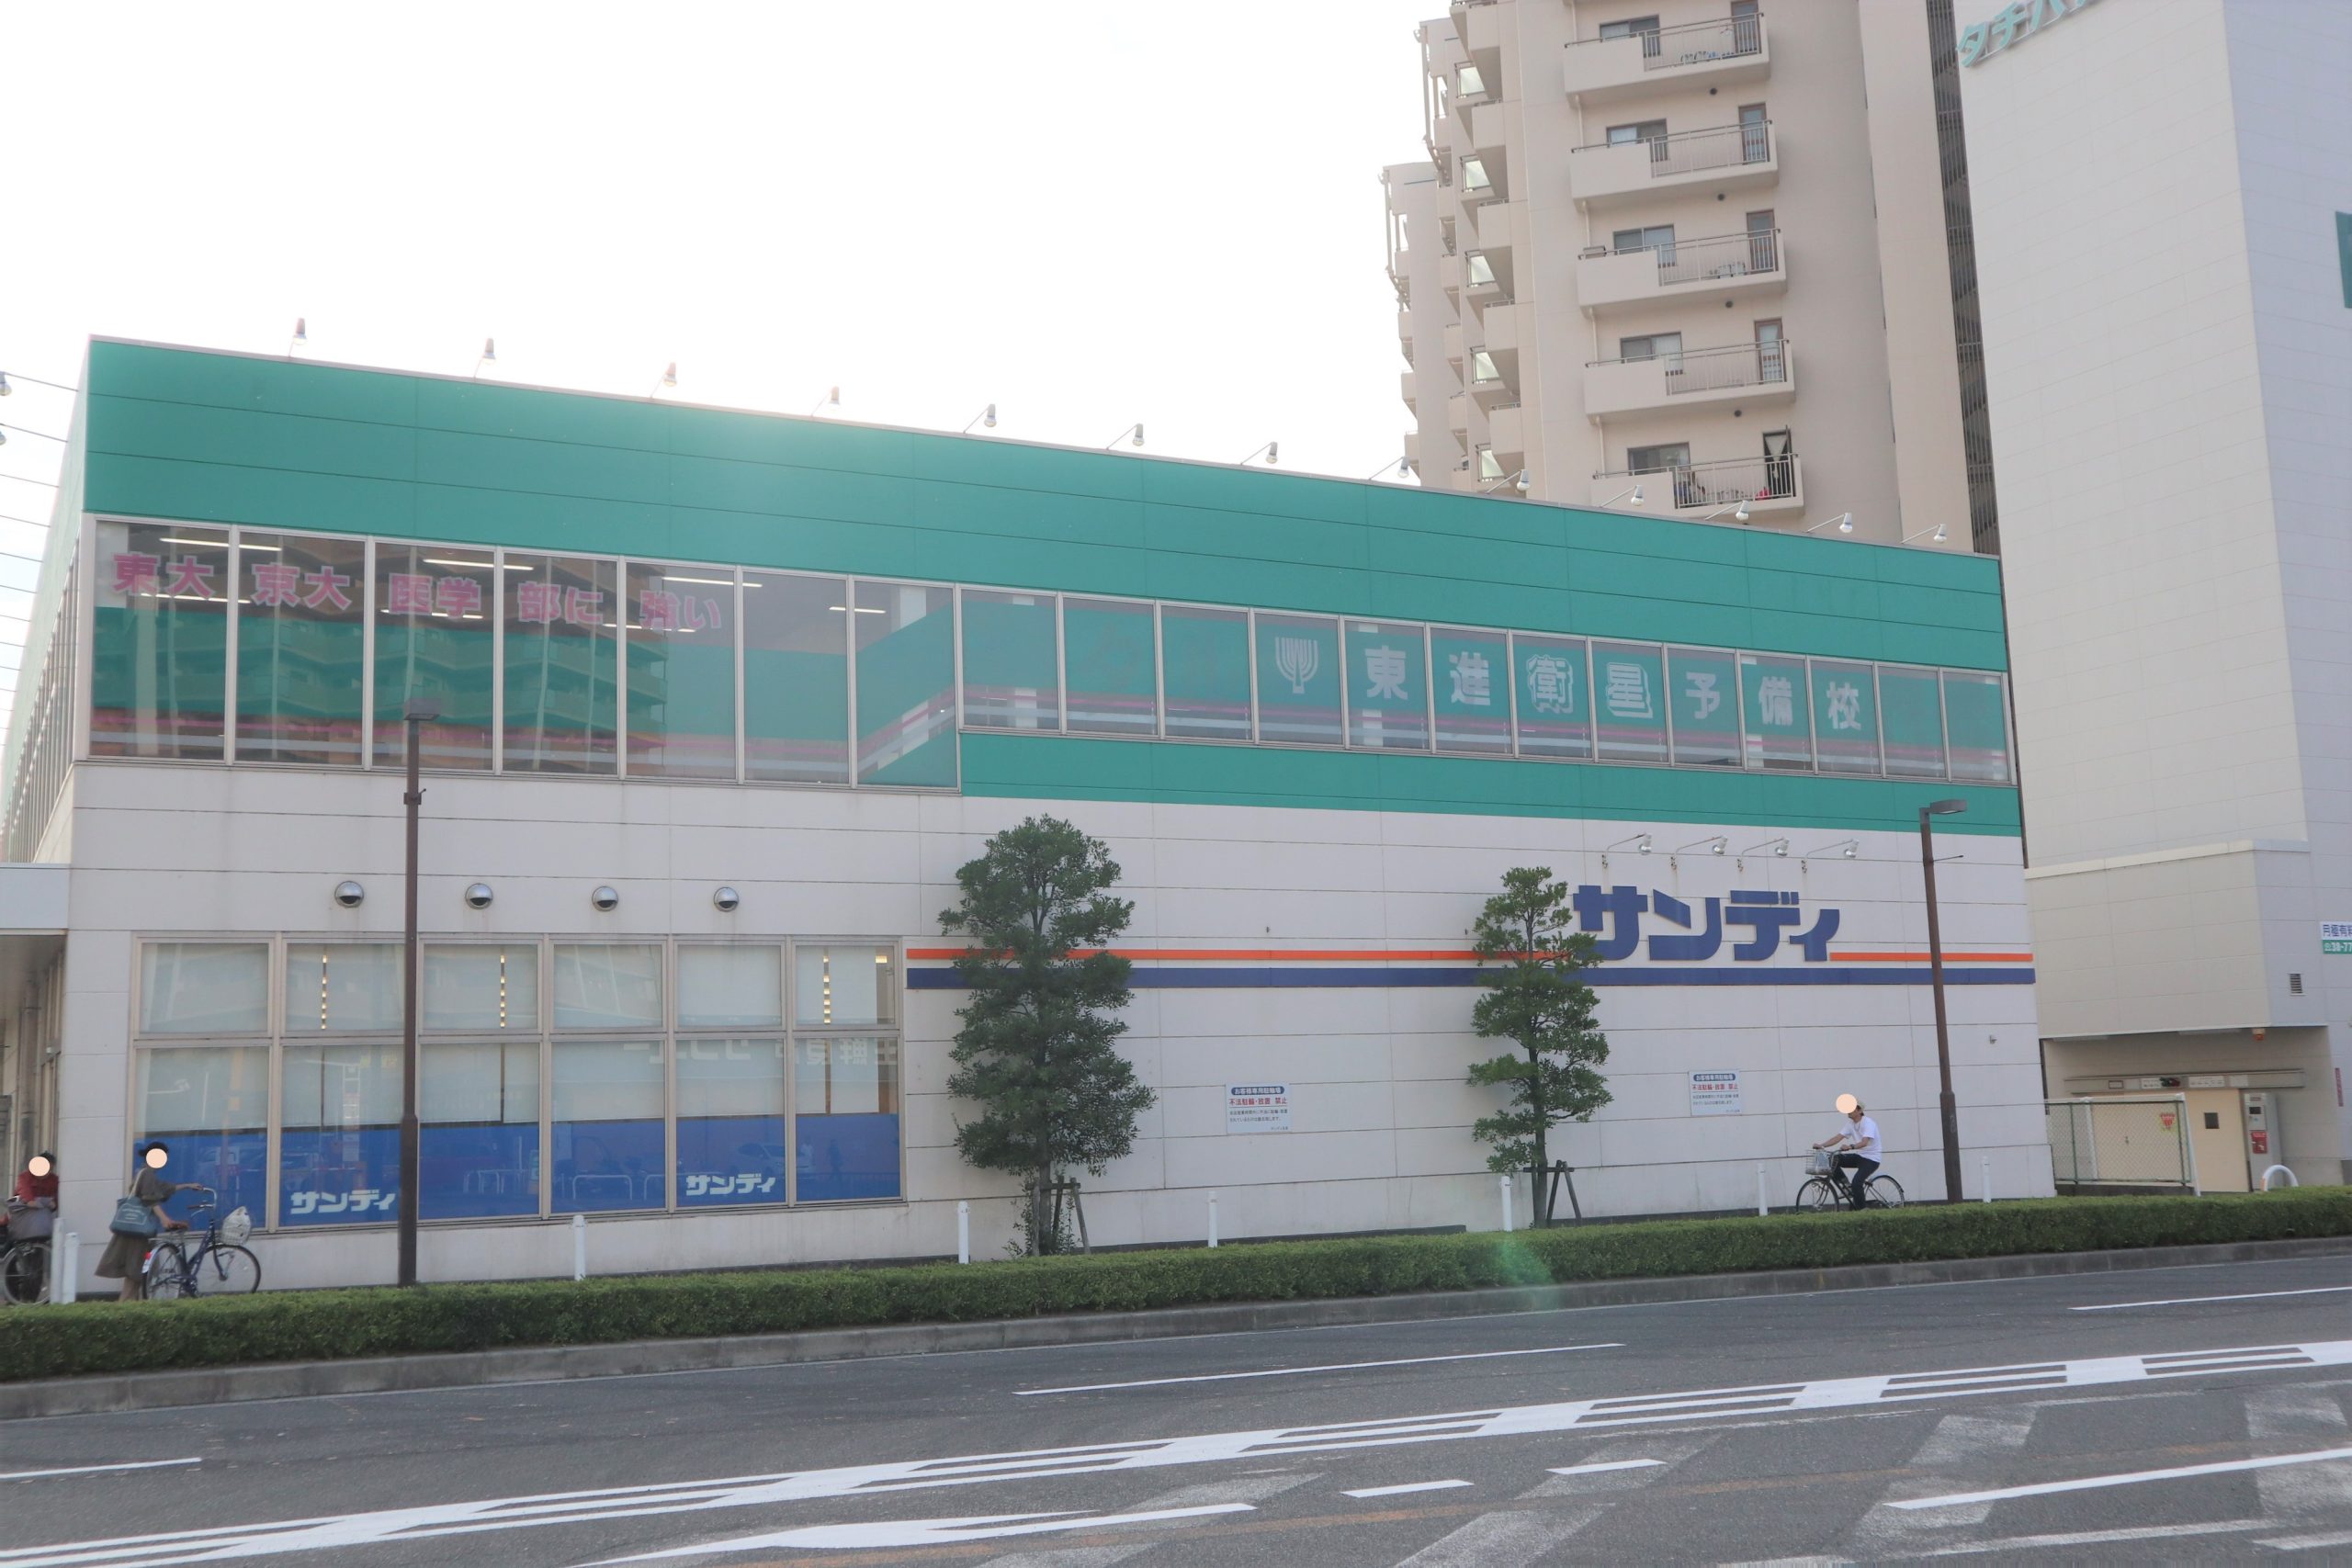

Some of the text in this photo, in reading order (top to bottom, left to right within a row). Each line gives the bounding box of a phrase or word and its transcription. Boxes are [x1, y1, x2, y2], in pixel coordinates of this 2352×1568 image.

[1573, 885, 1840, 962] サンディ
[685, 1174, 775, 1196] サンディ
[290, 1190, 395, 1213] サンディ
